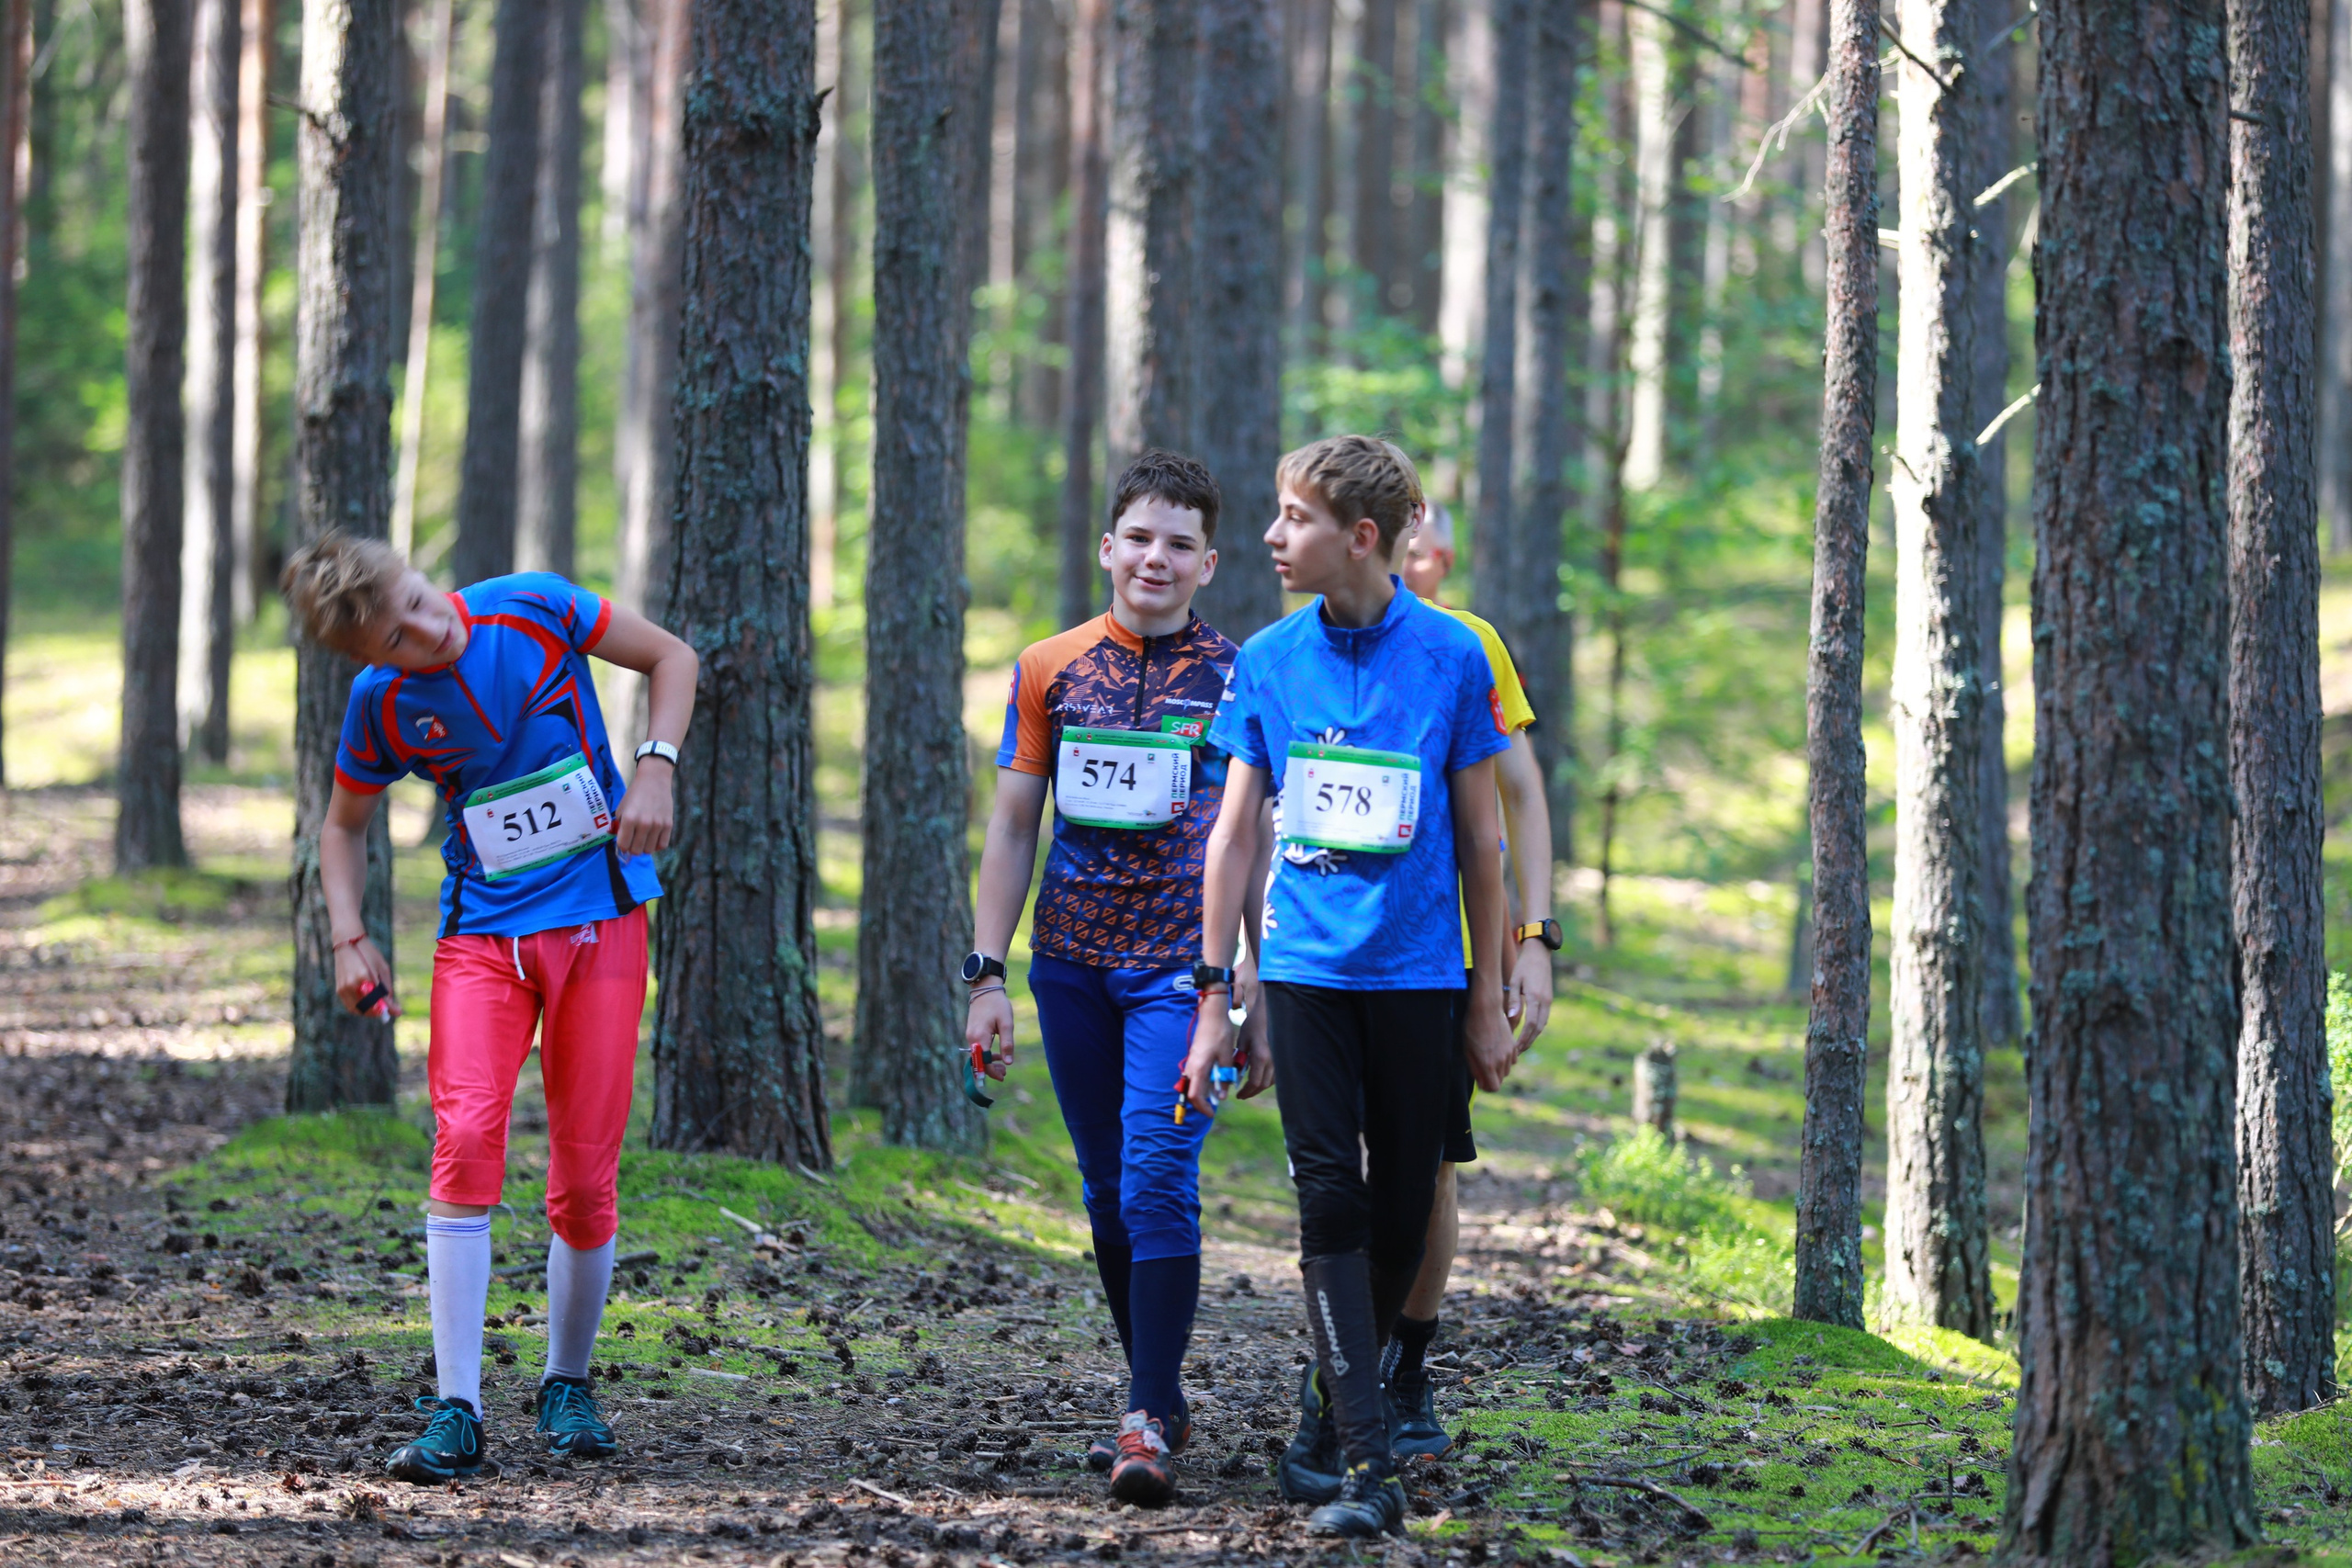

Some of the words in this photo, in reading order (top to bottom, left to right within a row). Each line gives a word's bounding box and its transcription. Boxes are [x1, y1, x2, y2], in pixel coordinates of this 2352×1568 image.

[1170, 721, 1201, 735] SFR
[1081, 759, 1136, 791] 574
[1170, 753, 1180, 798] ПЕРМСКИЙ
[1179, 764, 1188, 798] ПЕРИОД
[575, 772, 597, 814] ПЕРМСКИЙ
[588, 778, 605, 811] ПЕРИОД
[1315, 783, 1372, 817] 578
[1398, 773, 1409, 820] ПЕРМСКИЙ
[1407, 785, 1417, 821] ПЕРИОД
[503, 801, 562, 841] 512
